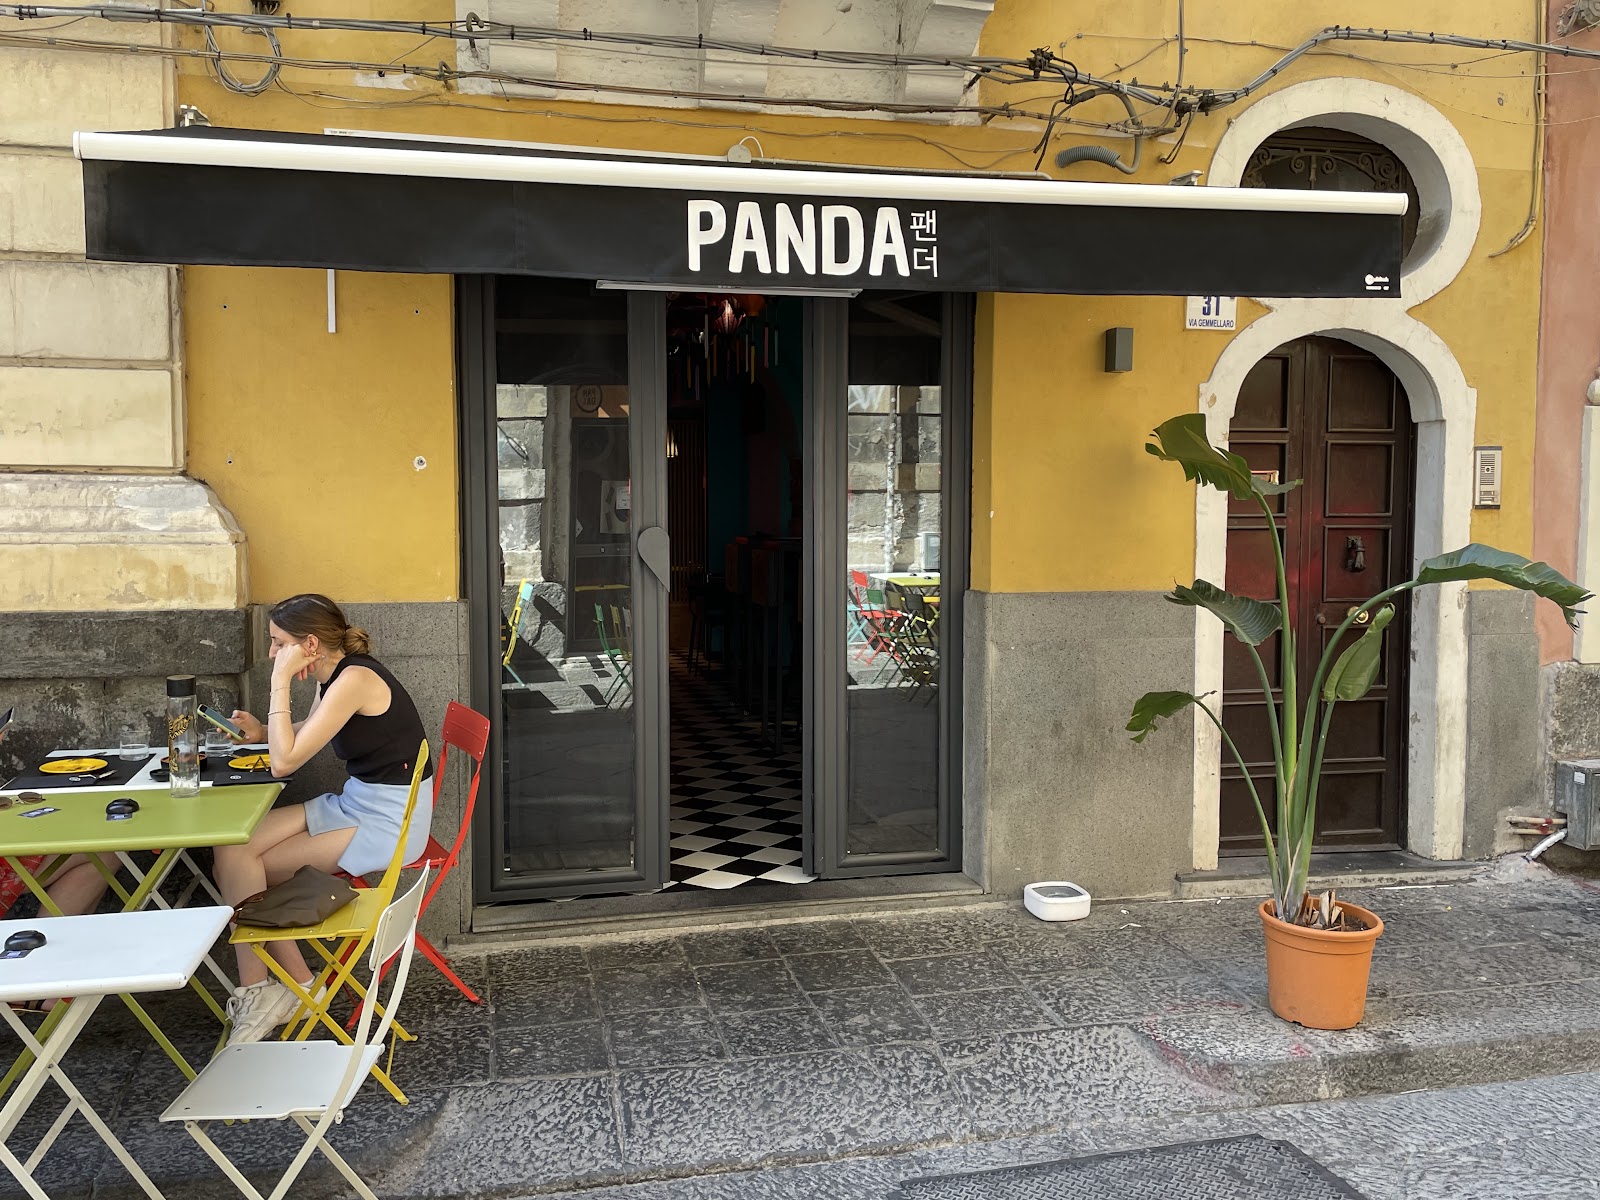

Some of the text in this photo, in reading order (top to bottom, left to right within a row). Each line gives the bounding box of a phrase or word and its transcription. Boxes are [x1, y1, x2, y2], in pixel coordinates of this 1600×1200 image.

[688, 199, 910, 277] PANDA
[910, 209, 938, 278] 팬더
[1189, 319, 1234, 328] VIA GEMMELLARO
[1202, 296, 1220, 316] 31
